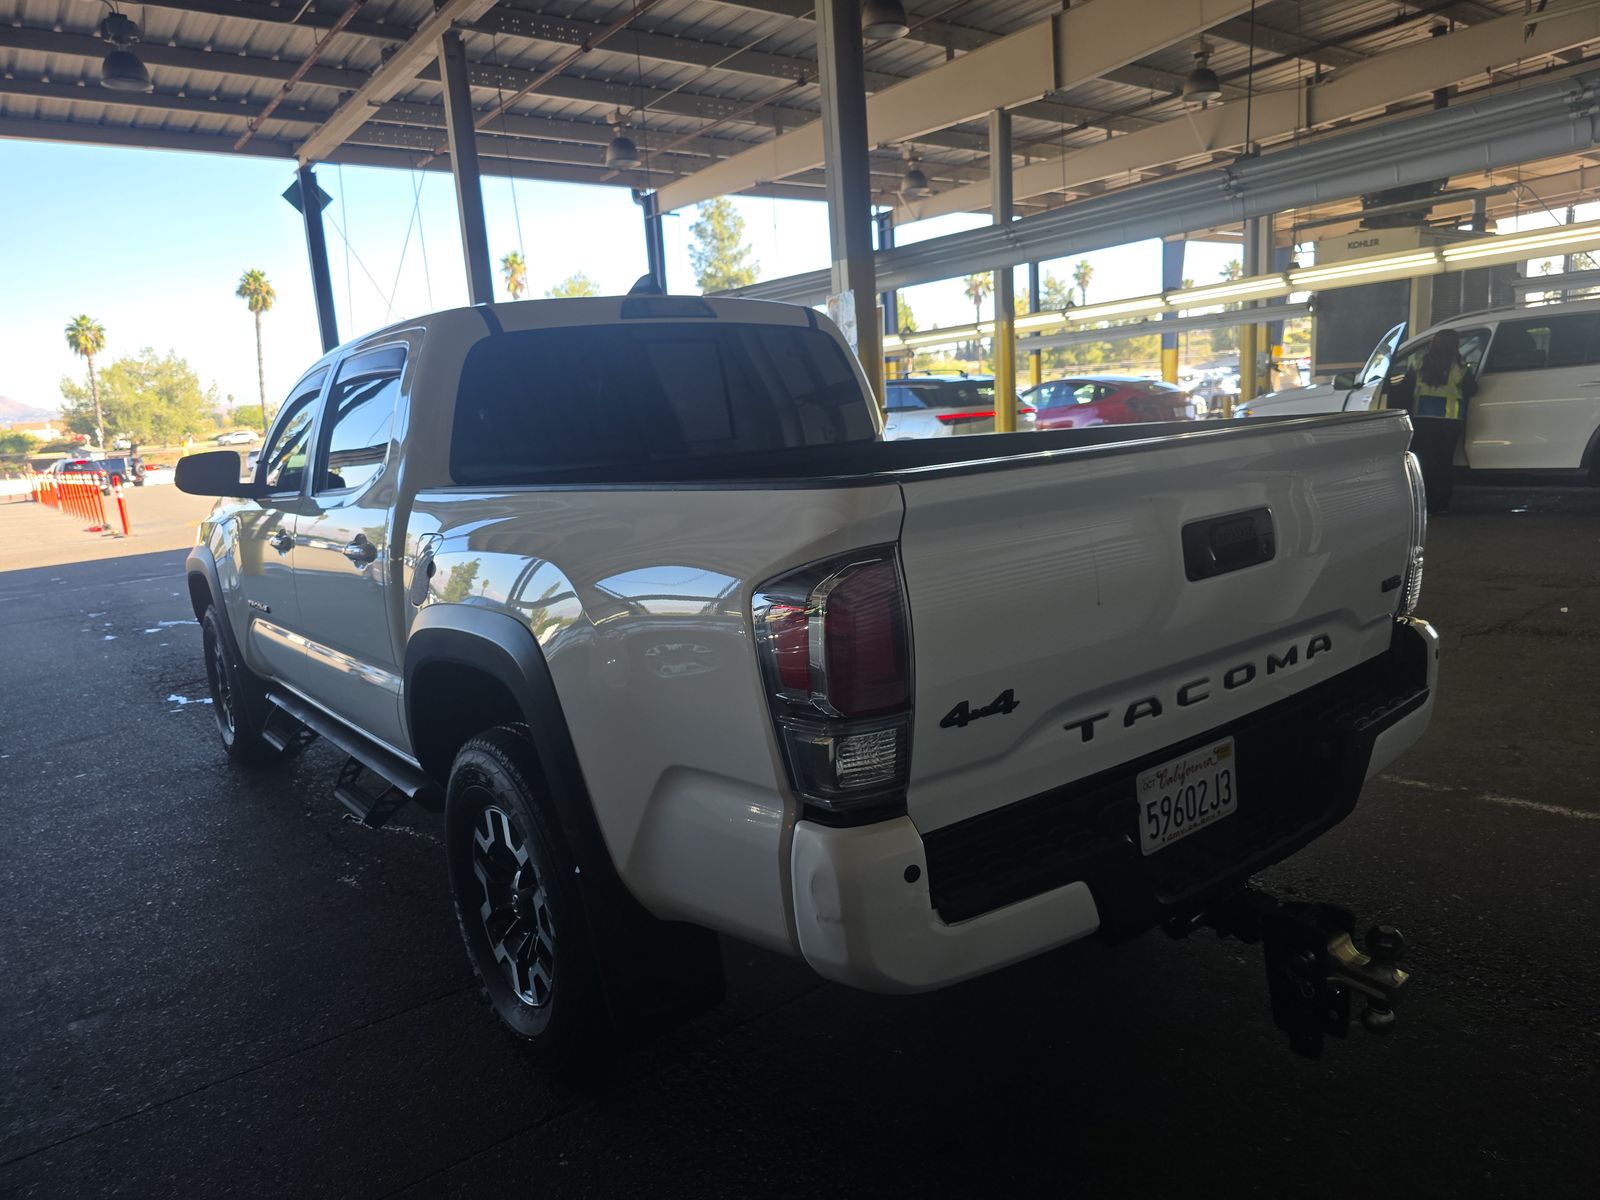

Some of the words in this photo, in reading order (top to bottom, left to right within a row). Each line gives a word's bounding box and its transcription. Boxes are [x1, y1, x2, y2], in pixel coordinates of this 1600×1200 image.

[1347, 238, 1380, 248] KOHLER
[1063, 632, 1332, 743] TACOMA
[939, 688, 1020, 728] 4x4
[1156, 756, 1218, 789] California
[1146, 769, 1231, 839] 59602J3
